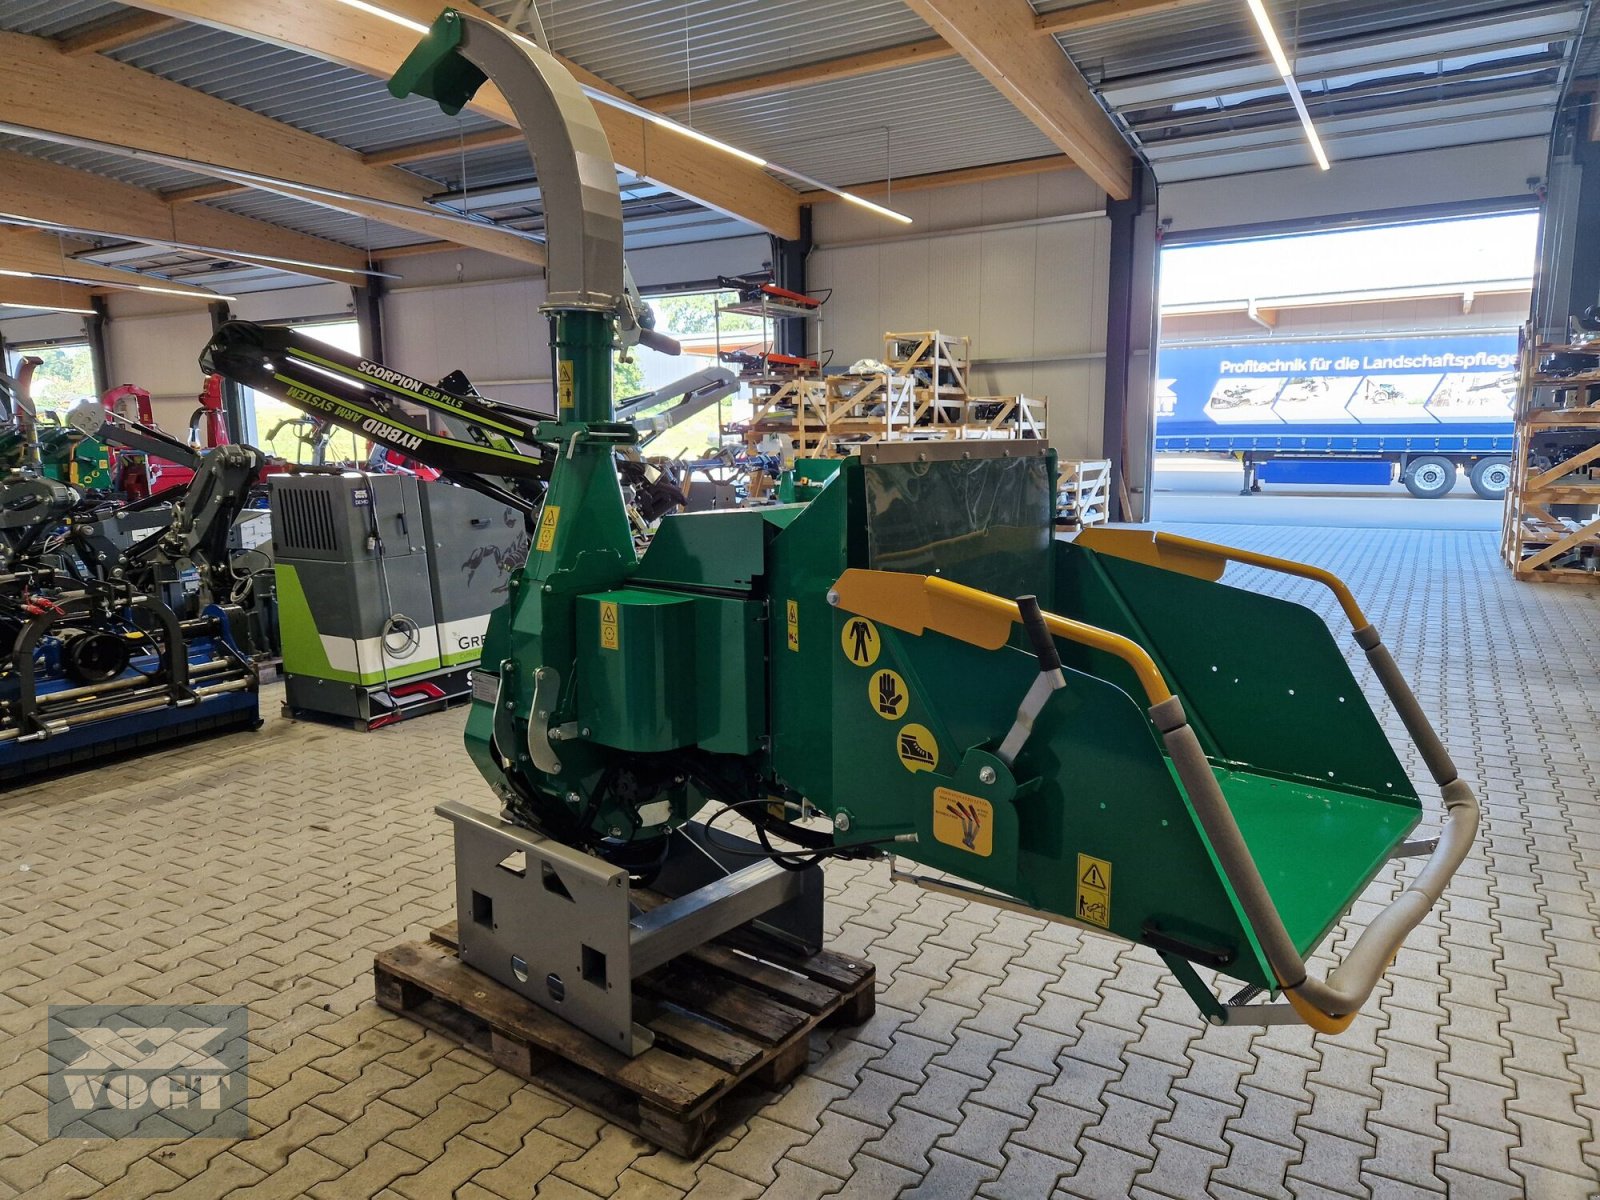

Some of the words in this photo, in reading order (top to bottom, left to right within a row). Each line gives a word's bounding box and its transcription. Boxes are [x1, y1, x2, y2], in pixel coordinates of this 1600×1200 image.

[1220, 358, 1307, 373] Profitechnik
[1309, 357, 1332, 371] für
[1334, 356, 1360, 370] die
[1363, 351, 1518, 369] Landschaftspflege
[358, 361, 423, 393] SCORPION
[422, 388, 441, 400] 630
[286, 386, 335, 412] SYSTEM
[334, 408, 363, 423] ARM
[362, 418, 423, 451] HYBRID
